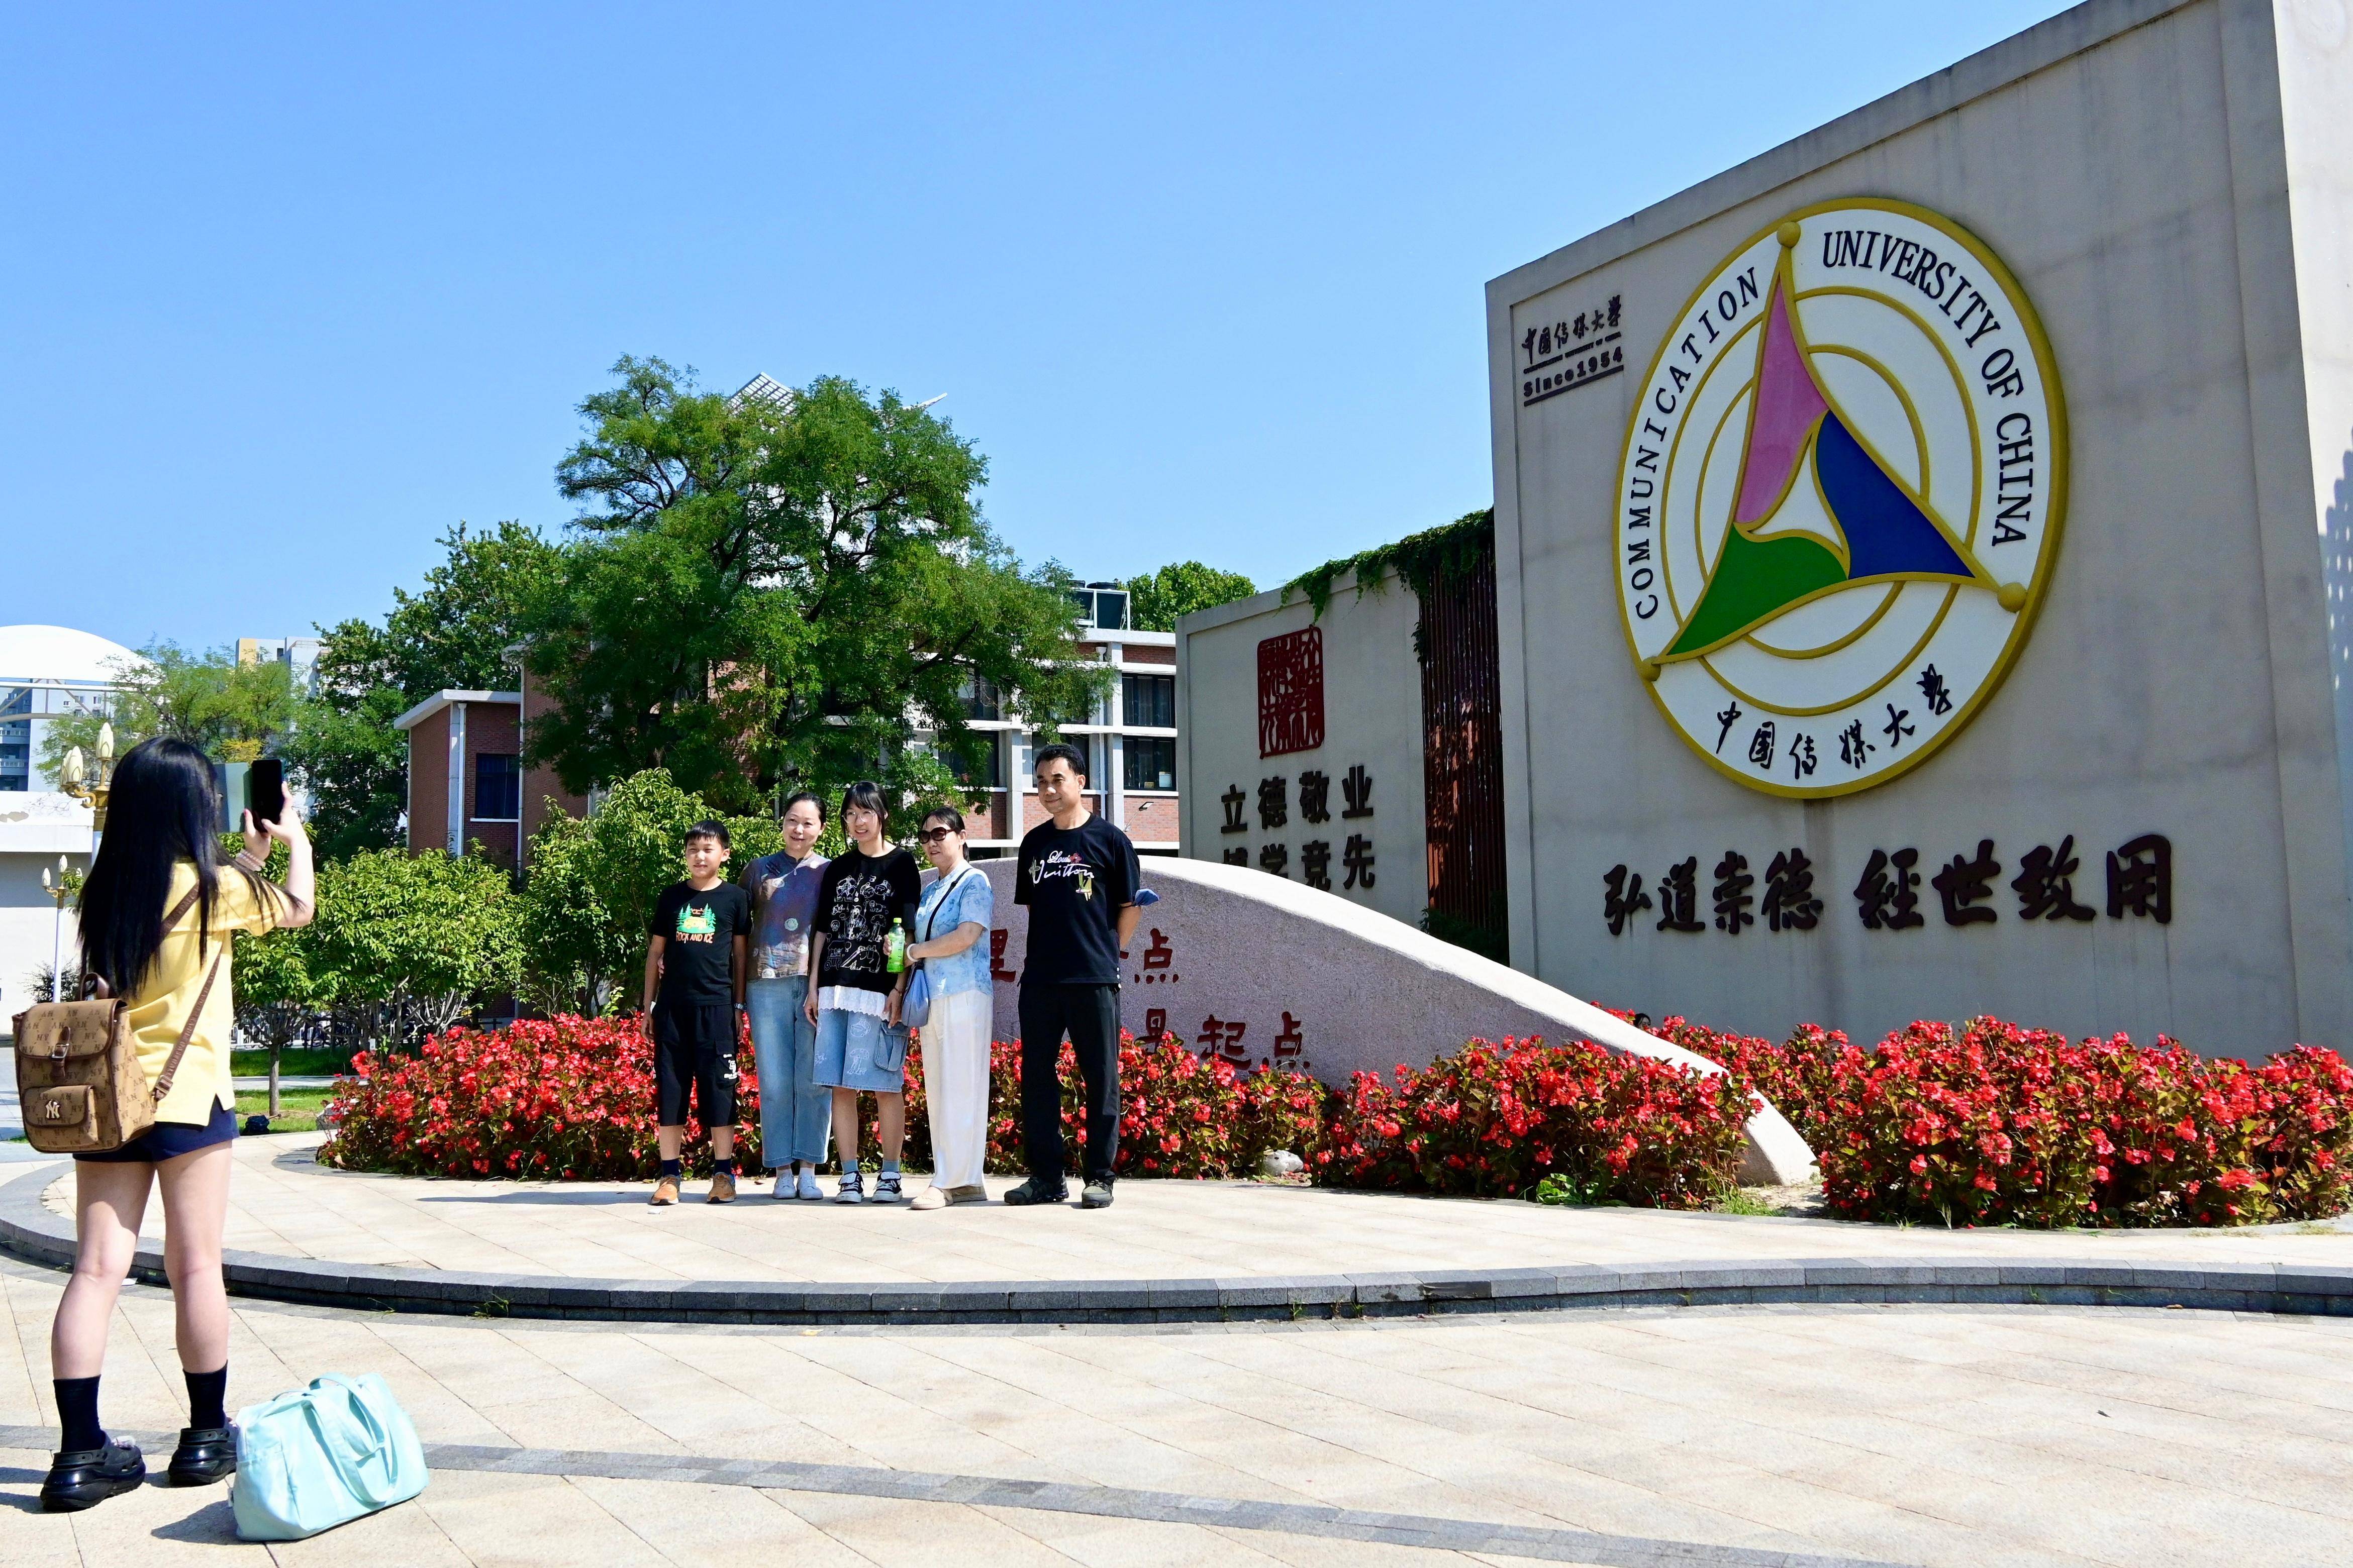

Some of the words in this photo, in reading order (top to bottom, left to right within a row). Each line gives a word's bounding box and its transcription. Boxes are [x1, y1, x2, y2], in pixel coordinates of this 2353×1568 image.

[1823, 230, 2000, 348] UNIVERSITY
[1981, 348, 2024, 399] OF
[1628, 268, 1759, 619] COMMUNICATION
[1993, 412, 2034, 547] CHINA
[1221, 766, 1374, 833] 立德敬业
[1604, 848, 1824, 935] 弘道崇德
[676, 931, 690, 944] ROCK
[690, 933, 703, 942] AND
[704, 932, 715, 944] ICE
